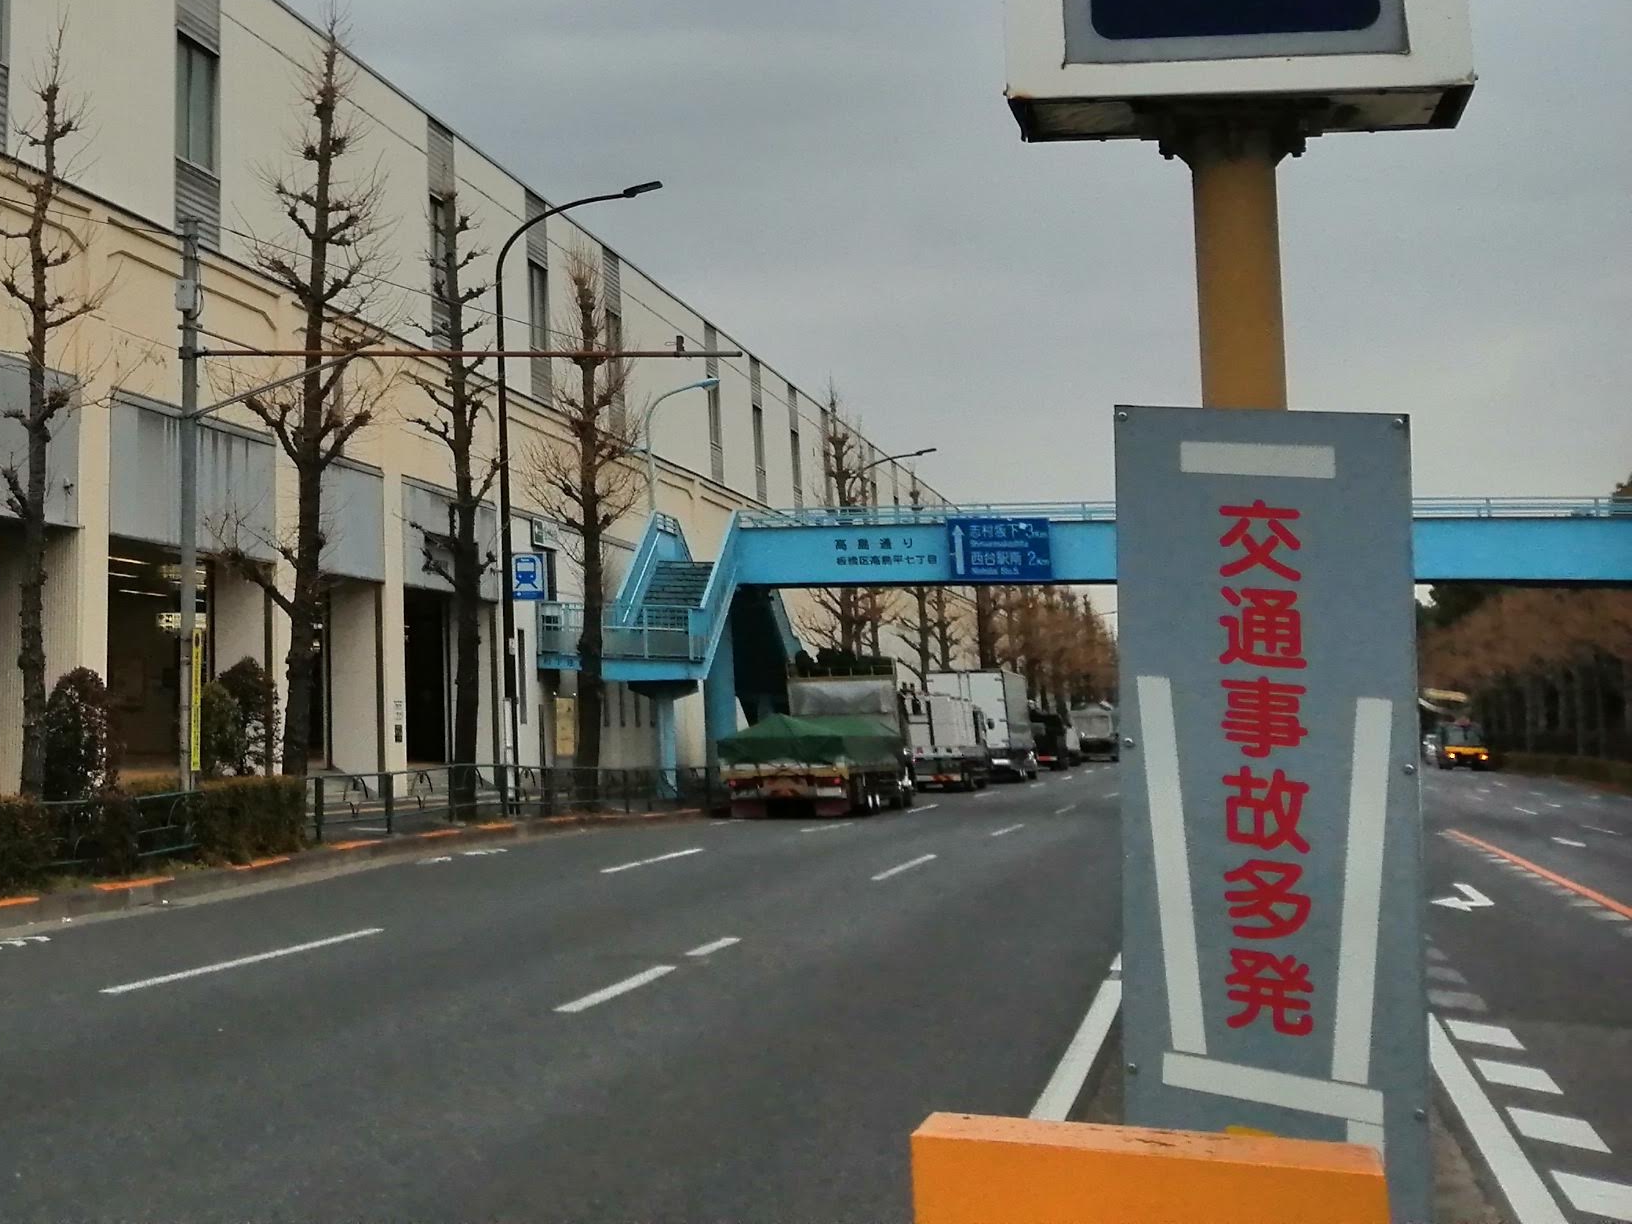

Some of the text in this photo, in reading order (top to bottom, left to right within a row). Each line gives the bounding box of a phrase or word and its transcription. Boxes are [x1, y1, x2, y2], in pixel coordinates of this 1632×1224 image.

[834, 537, 913, 551] 高島通り
[1218, 499, 1315, 1038] 交通事故多発
